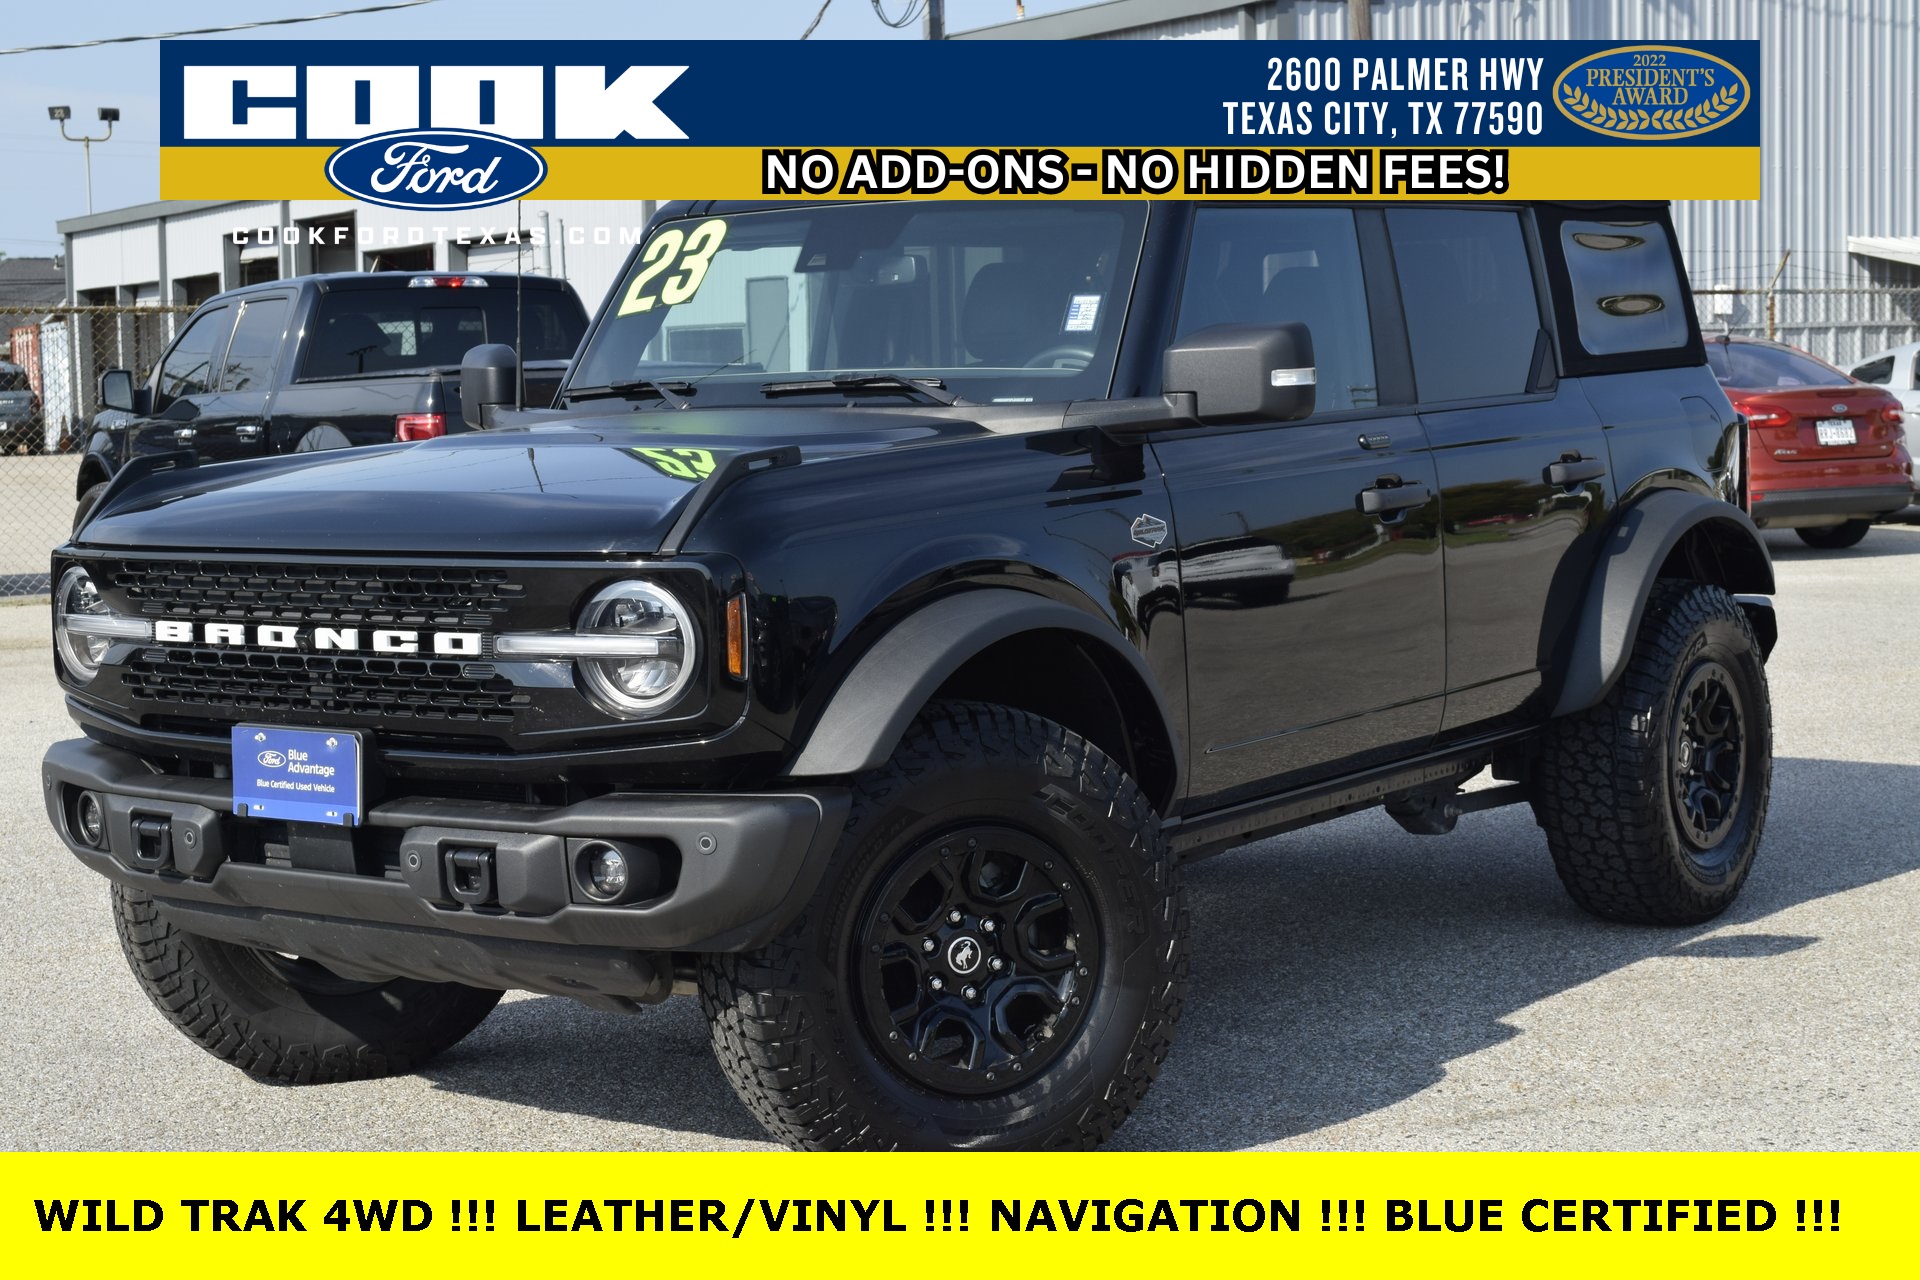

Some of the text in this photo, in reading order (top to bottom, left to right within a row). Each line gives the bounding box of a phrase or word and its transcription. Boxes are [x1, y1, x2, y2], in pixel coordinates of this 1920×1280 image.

[617, 218, 728, 317] 23
[155, 620, 482, 656] BRONCO
[262, 751, 281, 765] Ford
[288, 749, 308, 761] Blue
[288, 762, 335, 777] Advantage
[256, 779, 335, 793] Blue Certified Used Vehicle
